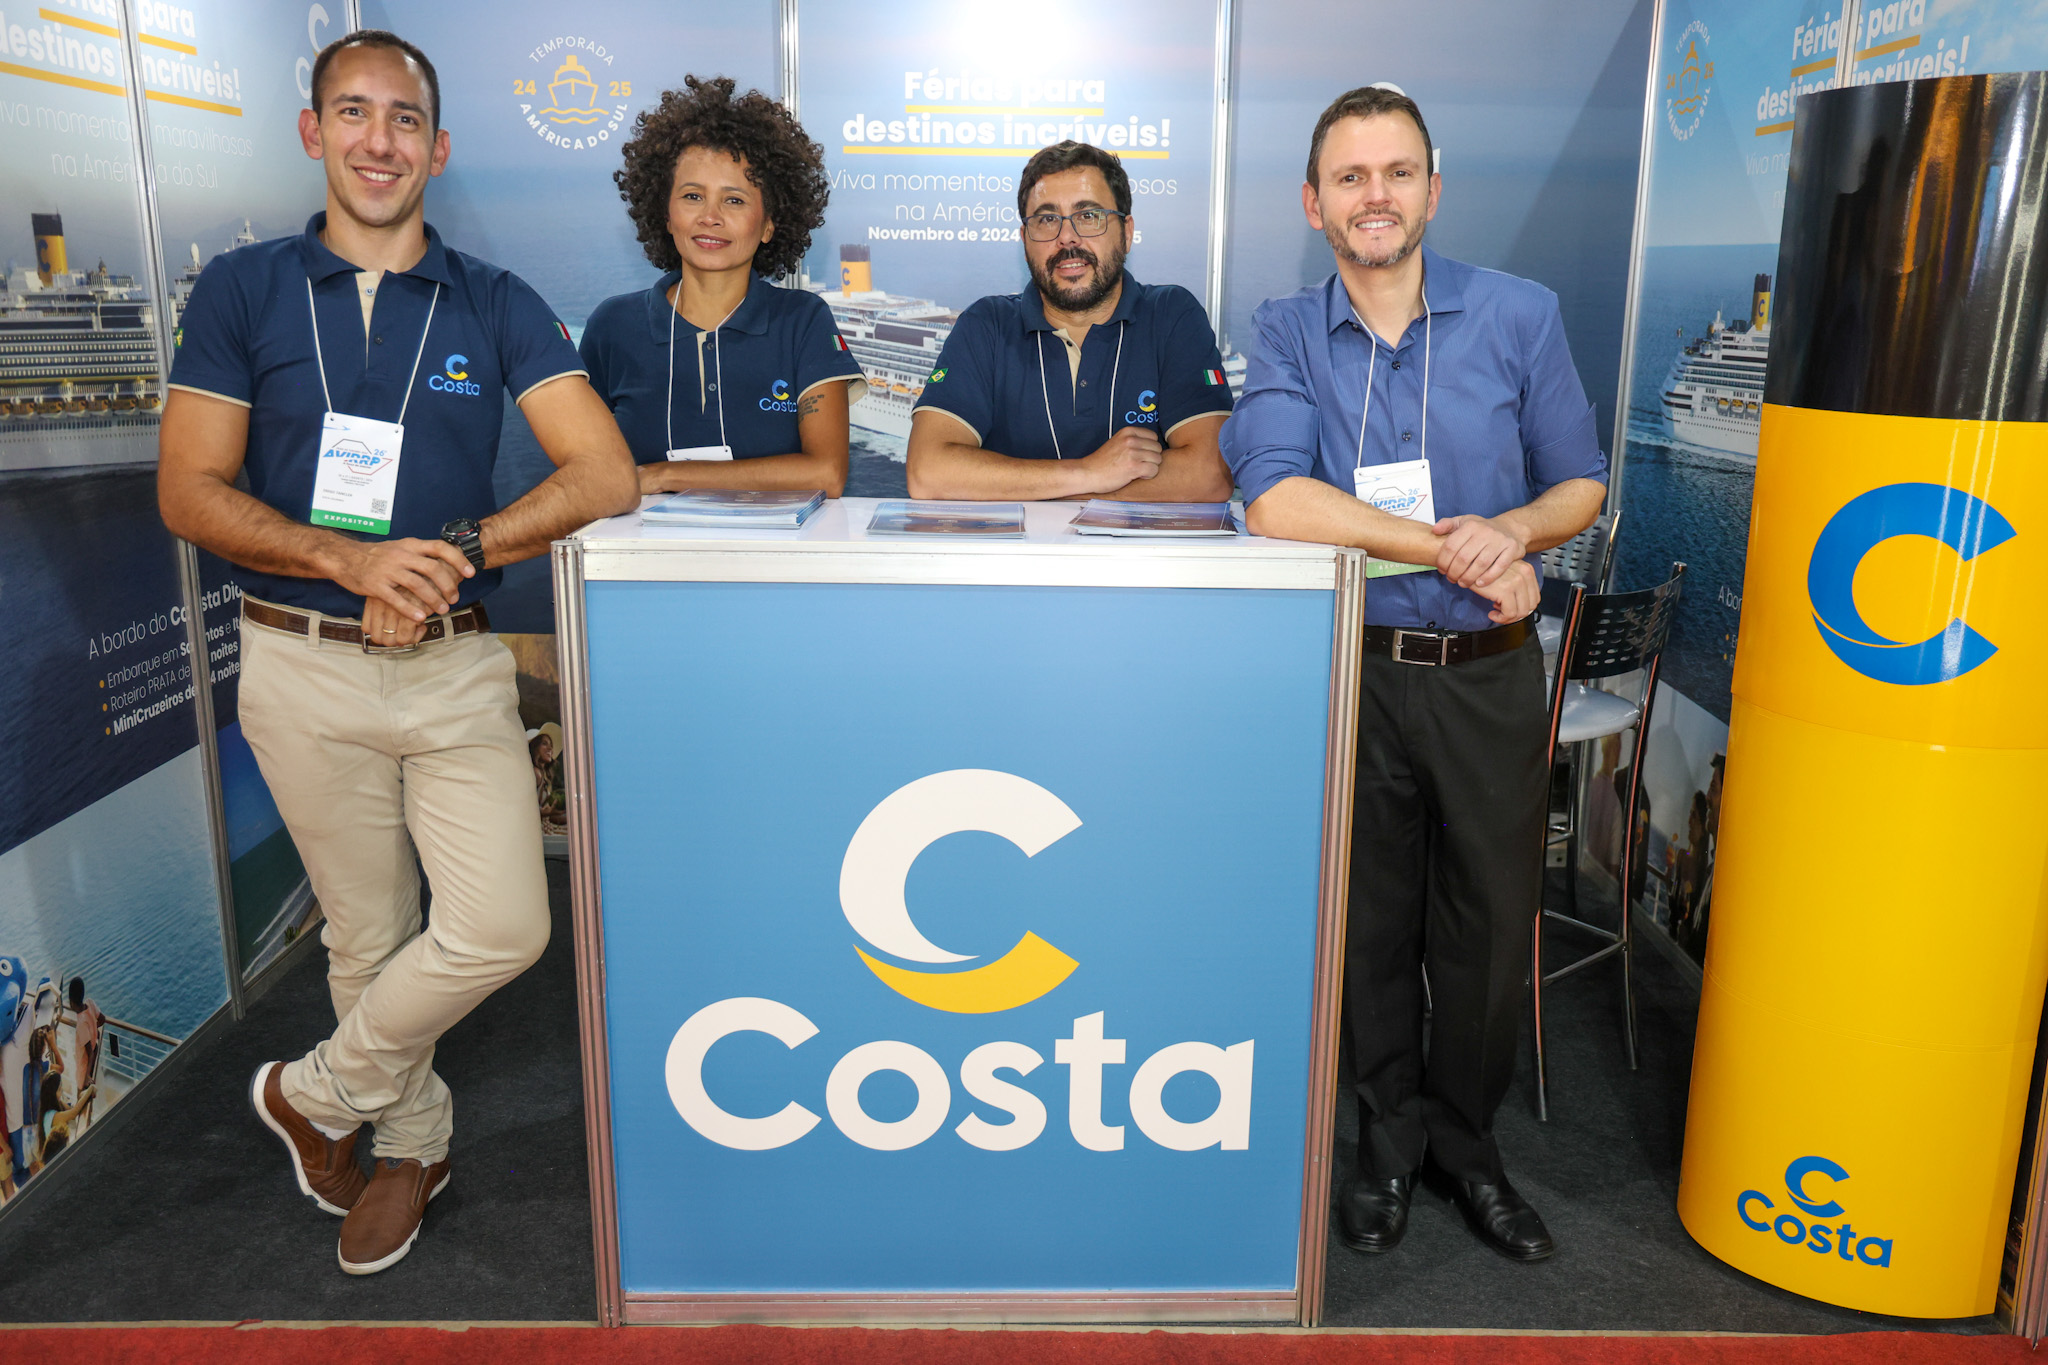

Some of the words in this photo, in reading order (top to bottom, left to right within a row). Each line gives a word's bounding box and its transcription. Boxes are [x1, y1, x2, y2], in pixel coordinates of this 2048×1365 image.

[138, 0, 196, 38] para
[1865, 0, 1926, 50] para
[529, 36, 615, 67] TEMPORADA
[1676, 20, 1710, 54] TEMPORADA
[121, 45, 241, 101] ncríveis!
[513, 79, 537, 95] 24
[609, 81, 632, 97] 25
[905, 68, 1013, 101] Férias
[1020, 79, 1105, 109] para
[1666, 73, 1676, 90] 24
[1704, 61, 1714, 79] 25
[0, 100, 30, 127] iva
[36, 105, 130, 142] momento
[154, 122, 254, 157] maravilhosos
[520, 103, 585, 150] AMÉRICA
[587, 129, 609, 148] DO
[607, 103, 628, 132] SUL
[842, 114, 996, 144] destinos
[1003, 113, 1171, 147] incríveis!
[51, 153, 78, 177] na
[84, 152, 168, 186] Améria
[172, 160, 193, 187] do
[196, 163, 218, 189] Sul
[827, 169, 876, 190] Viva
[884, 172, 1013, 193] momentos
[895, 204, 925, 221] na
[868, 226, 954, 241] Novembro
[957, 227, 978, 242] de
[981, 227, 1021, 242] 2024
[428, 374, 481, 396] Costa
[1125, 410, 1159, 424] Cost
[323, 449, 381, 466] AVIRRP
[324, 514, 375, 527] EXPOSITOR
[1718, 585, 1724, 603] A
[89, 638, 99, 660] A
[102, 620, 146, 655] bordo
[149, 612, 168, 635] do
[107, 655, 161, 689] Embarque
[162, 648, 179, 665] em
[225, 622, 232, 635] e
[110, 686, 147, 712] Roteiro
[147, 670, 177, 695] PRATA
[177, 664, 191, 678] de
[210, 640, 239, 663] noites
[113, 691, 185, 736] MiniCruzeiros
[184, 684, 196, 699] de
[210, 670, 217, 685] 4
[217, 661, 240, 682] noite
[665, 997, 1255, 1152] Costa
[1737, 1189, 1894, 1269] Costa
